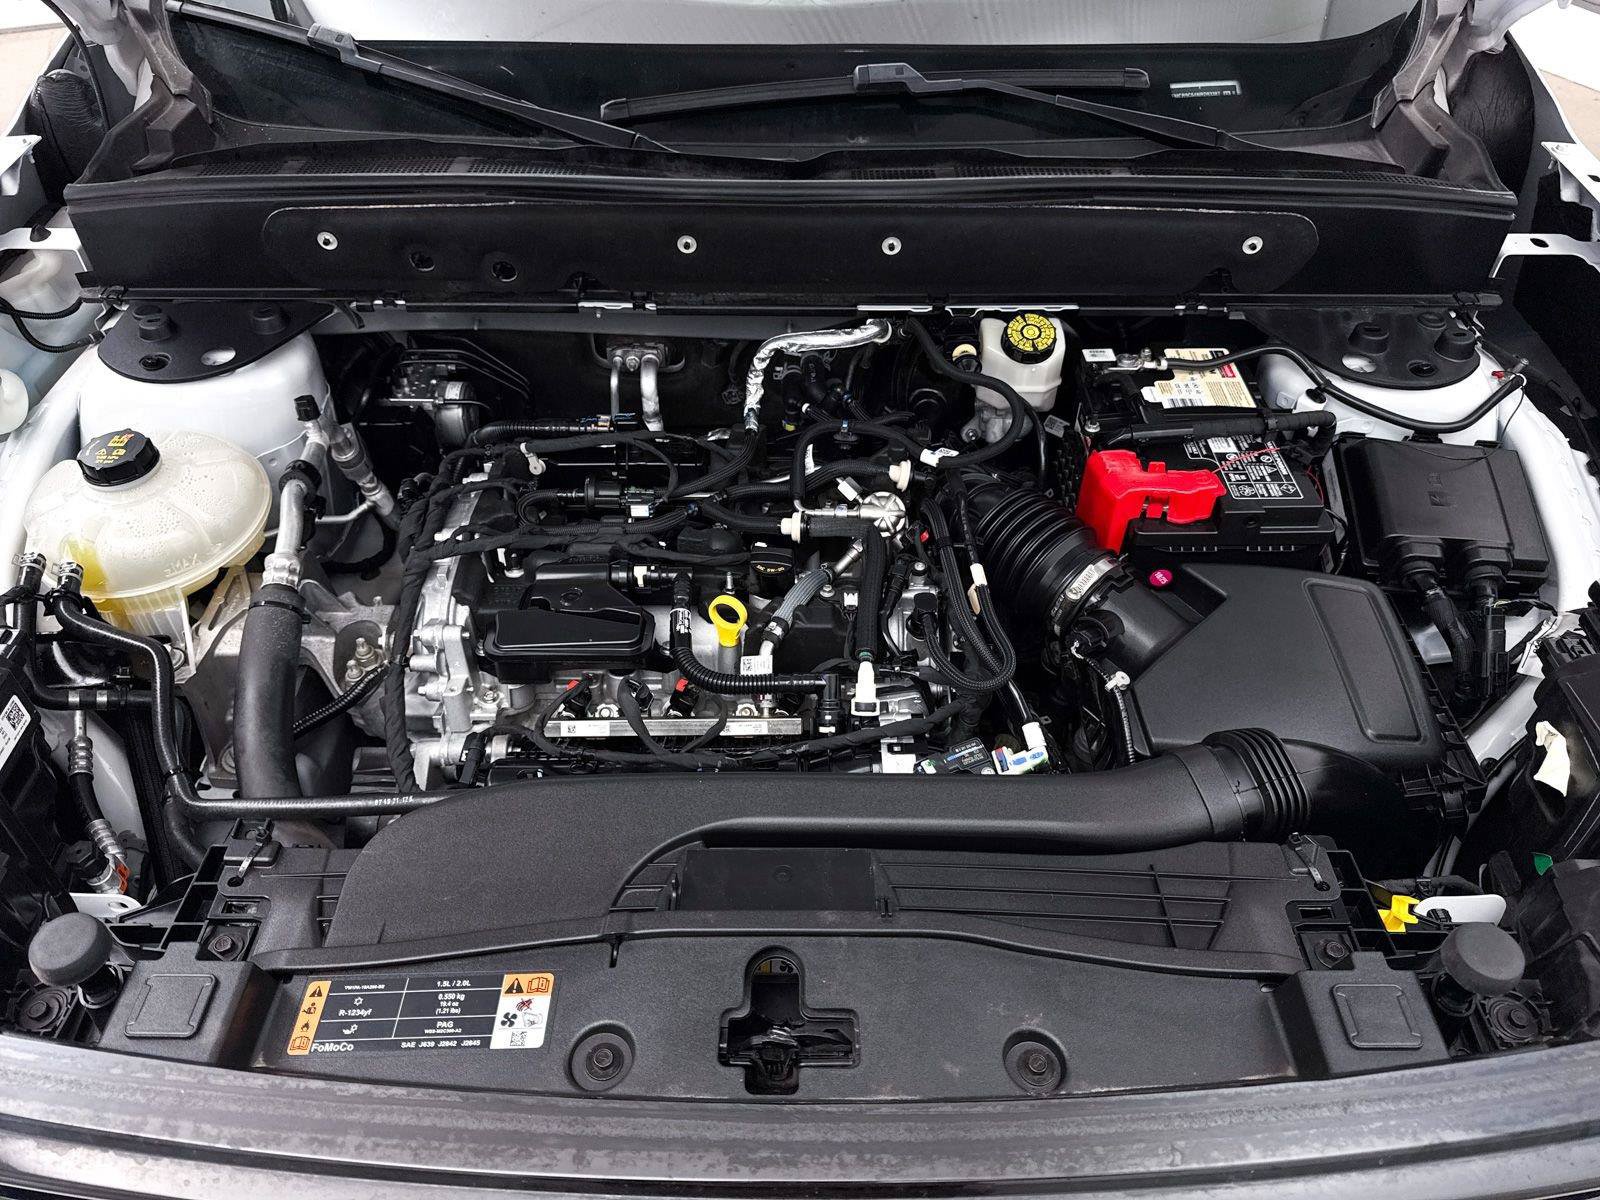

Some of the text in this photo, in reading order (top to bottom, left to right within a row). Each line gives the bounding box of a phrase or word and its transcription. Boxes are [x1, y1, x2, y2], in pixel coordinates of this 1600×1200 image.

[456, 979, 471, 987] 2.0L
[437, 992, 465, 1001] 0.550 kg
[338, 1008, 373, 1018] R-1234yf
[436, 1021, 454, 1029] PAG
[310, 1041, 354, 1053] FoMoCo
[400, 1041, 417, 1049] SAE
